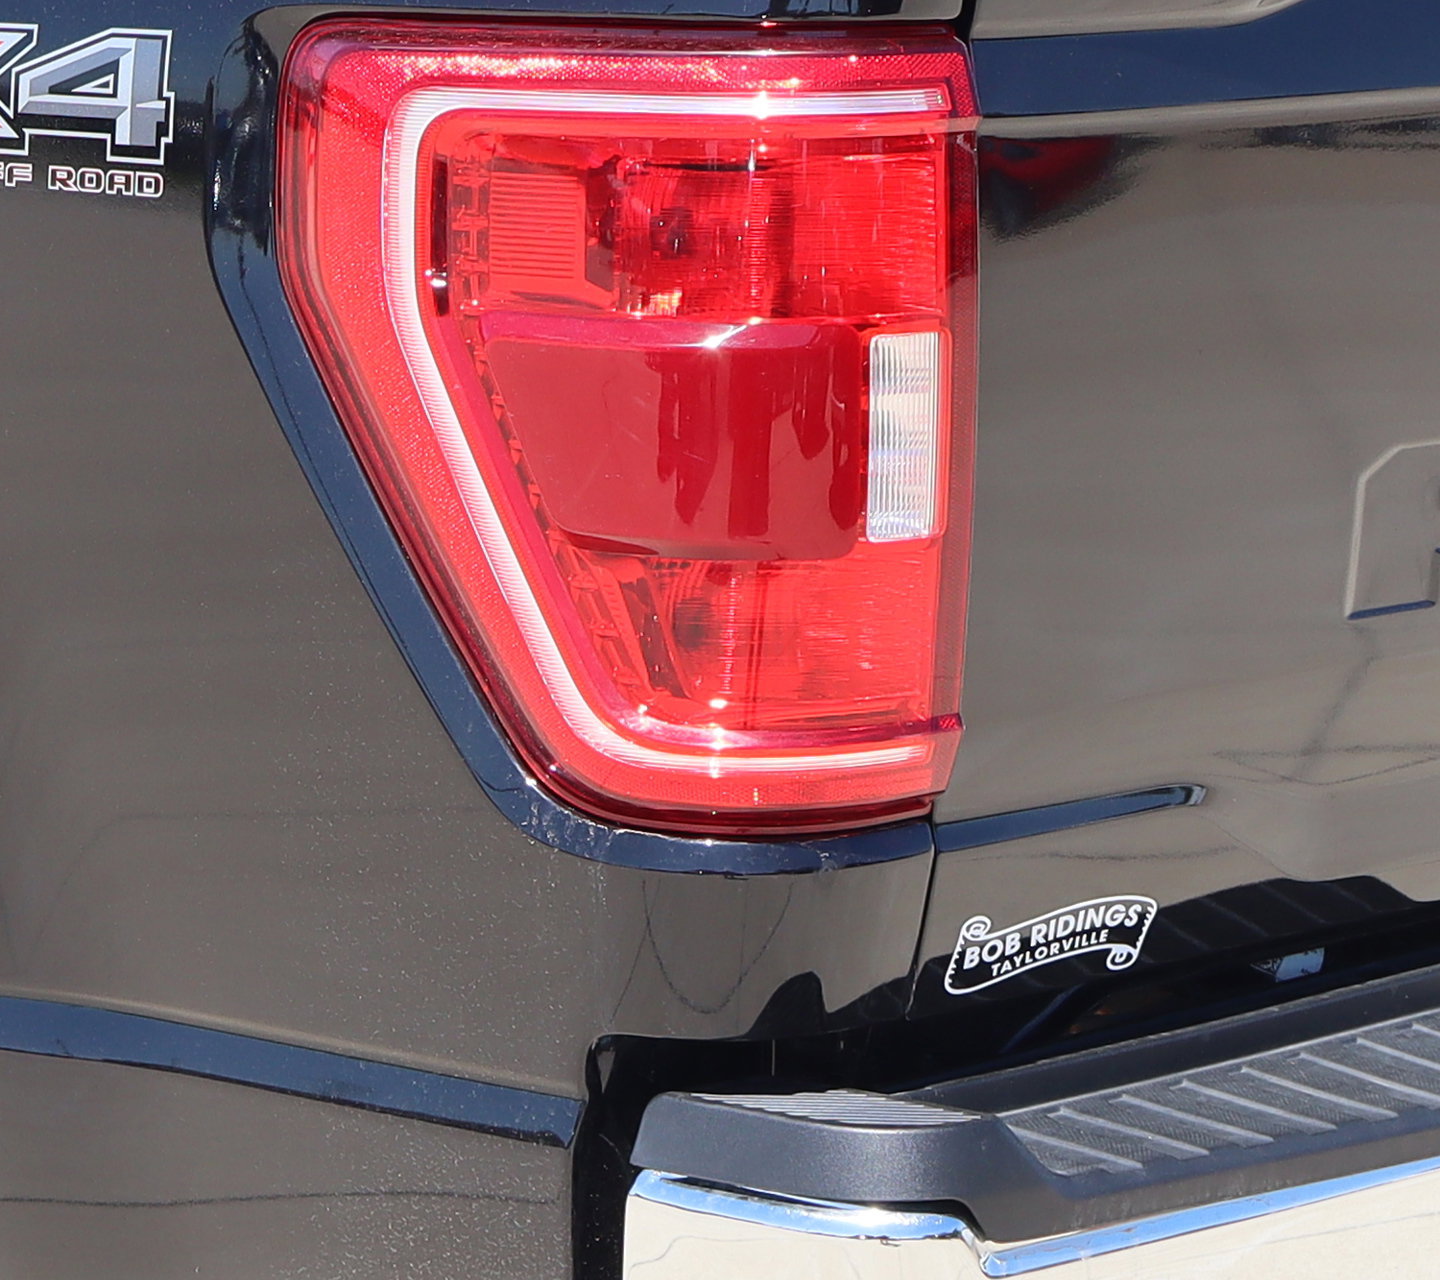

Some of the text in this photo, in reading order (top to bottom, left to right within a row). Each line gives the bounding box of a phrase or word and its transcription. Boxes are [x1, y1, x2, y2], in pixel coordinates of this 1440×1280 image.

[48, 165, 165, 198] ROAD
[963, 903, 1142, 970] BOB RIDINGS
[991, 929, 1109, 977] TAYLORVILLE
